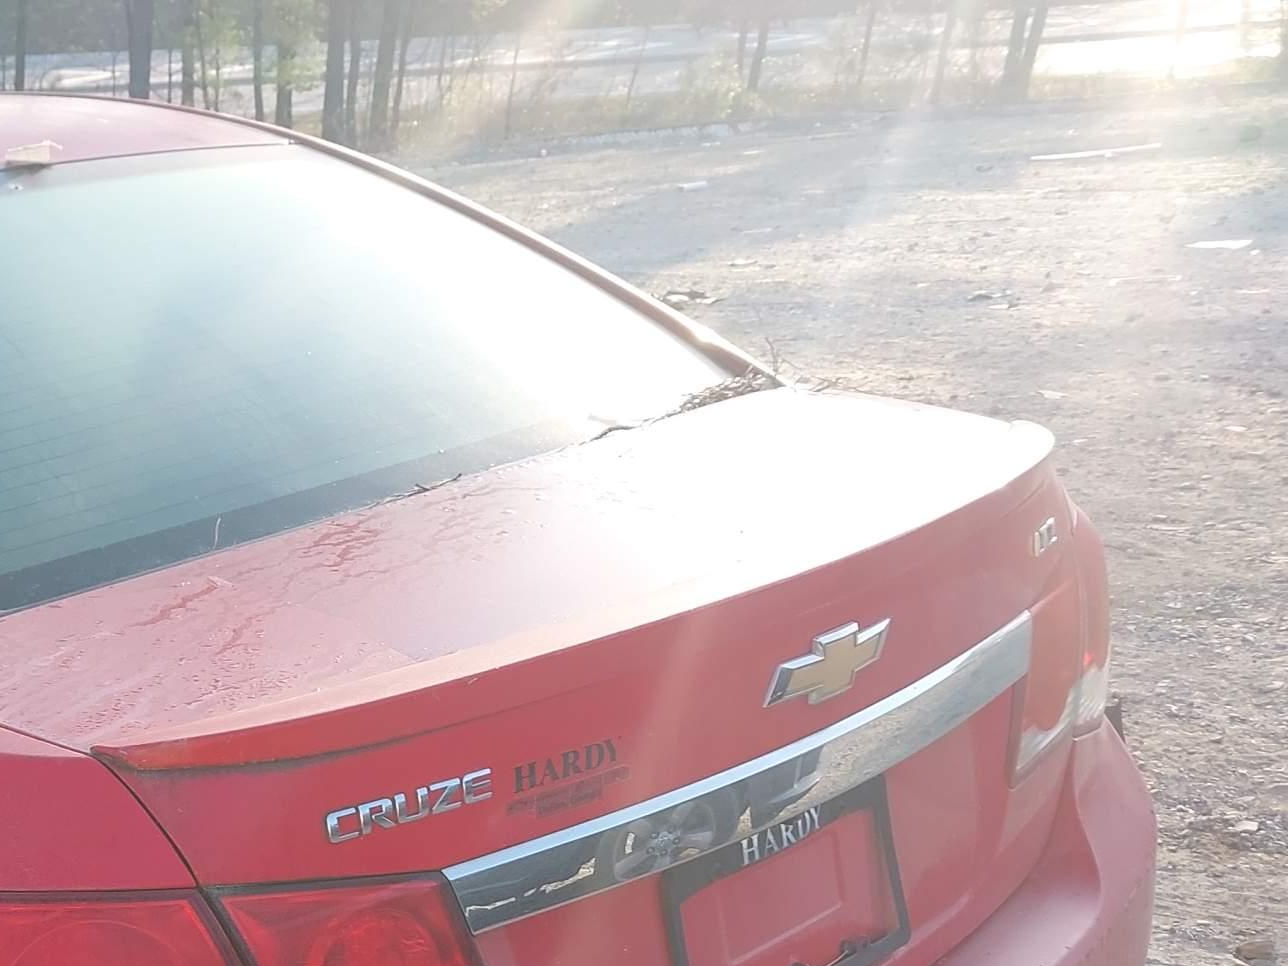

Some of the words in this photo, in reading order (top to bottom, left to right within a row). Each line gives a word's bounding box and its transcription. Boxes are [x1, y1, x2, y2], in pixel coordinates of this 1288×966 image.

[512, 735, 622, 793] HARDY
[326, 767, 493, 844] CRUZE
[740, 803, 821, 866] HARDY
